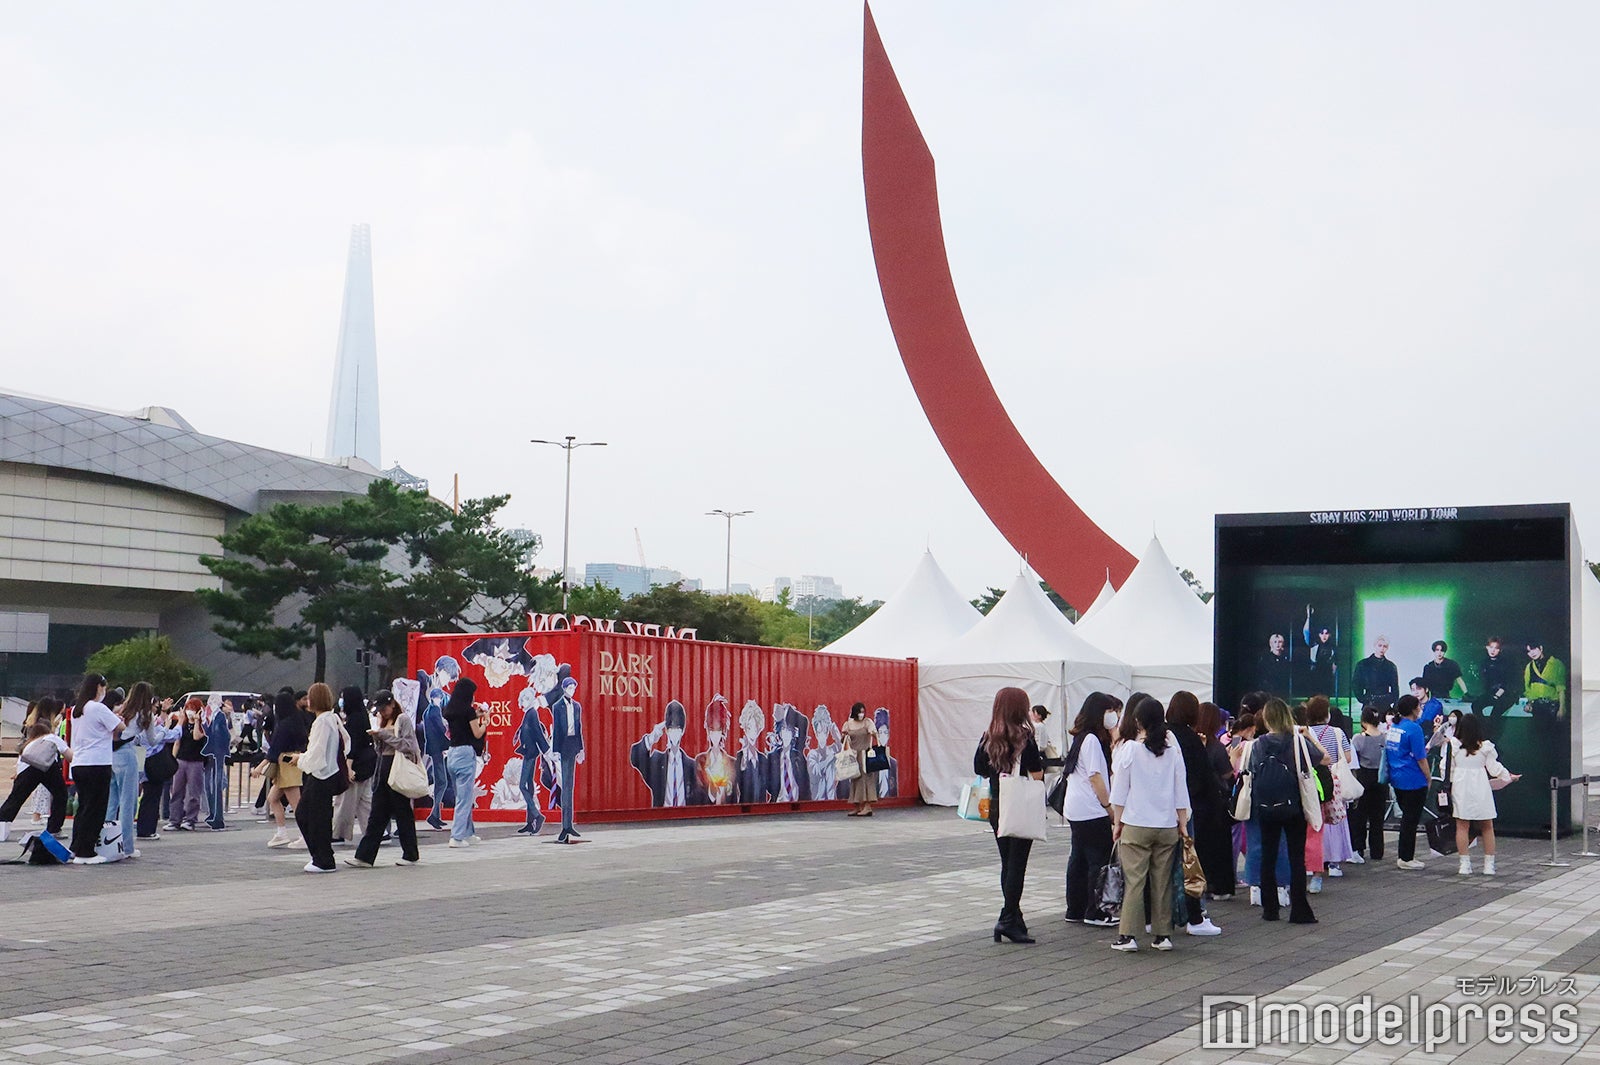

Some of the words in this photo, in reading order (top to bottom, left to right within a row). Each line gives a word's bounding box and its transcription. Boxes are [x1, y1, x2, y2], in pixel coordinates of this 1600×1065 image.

[1310, 512, 1340, 523] STRAY
[1343, 511, 1366, 522] KIDS
[1369, 510, 1389, 522] 2ND
[1392, 509, 1428, 521] WORLD
[1430, 508, 1458, 519] TOUR
[600, 651, 654, 675] DARK
[600, 675, 654, 698] MOON
[490, 701, 511, 713] RK
[487, 714, 512, 727] ON
